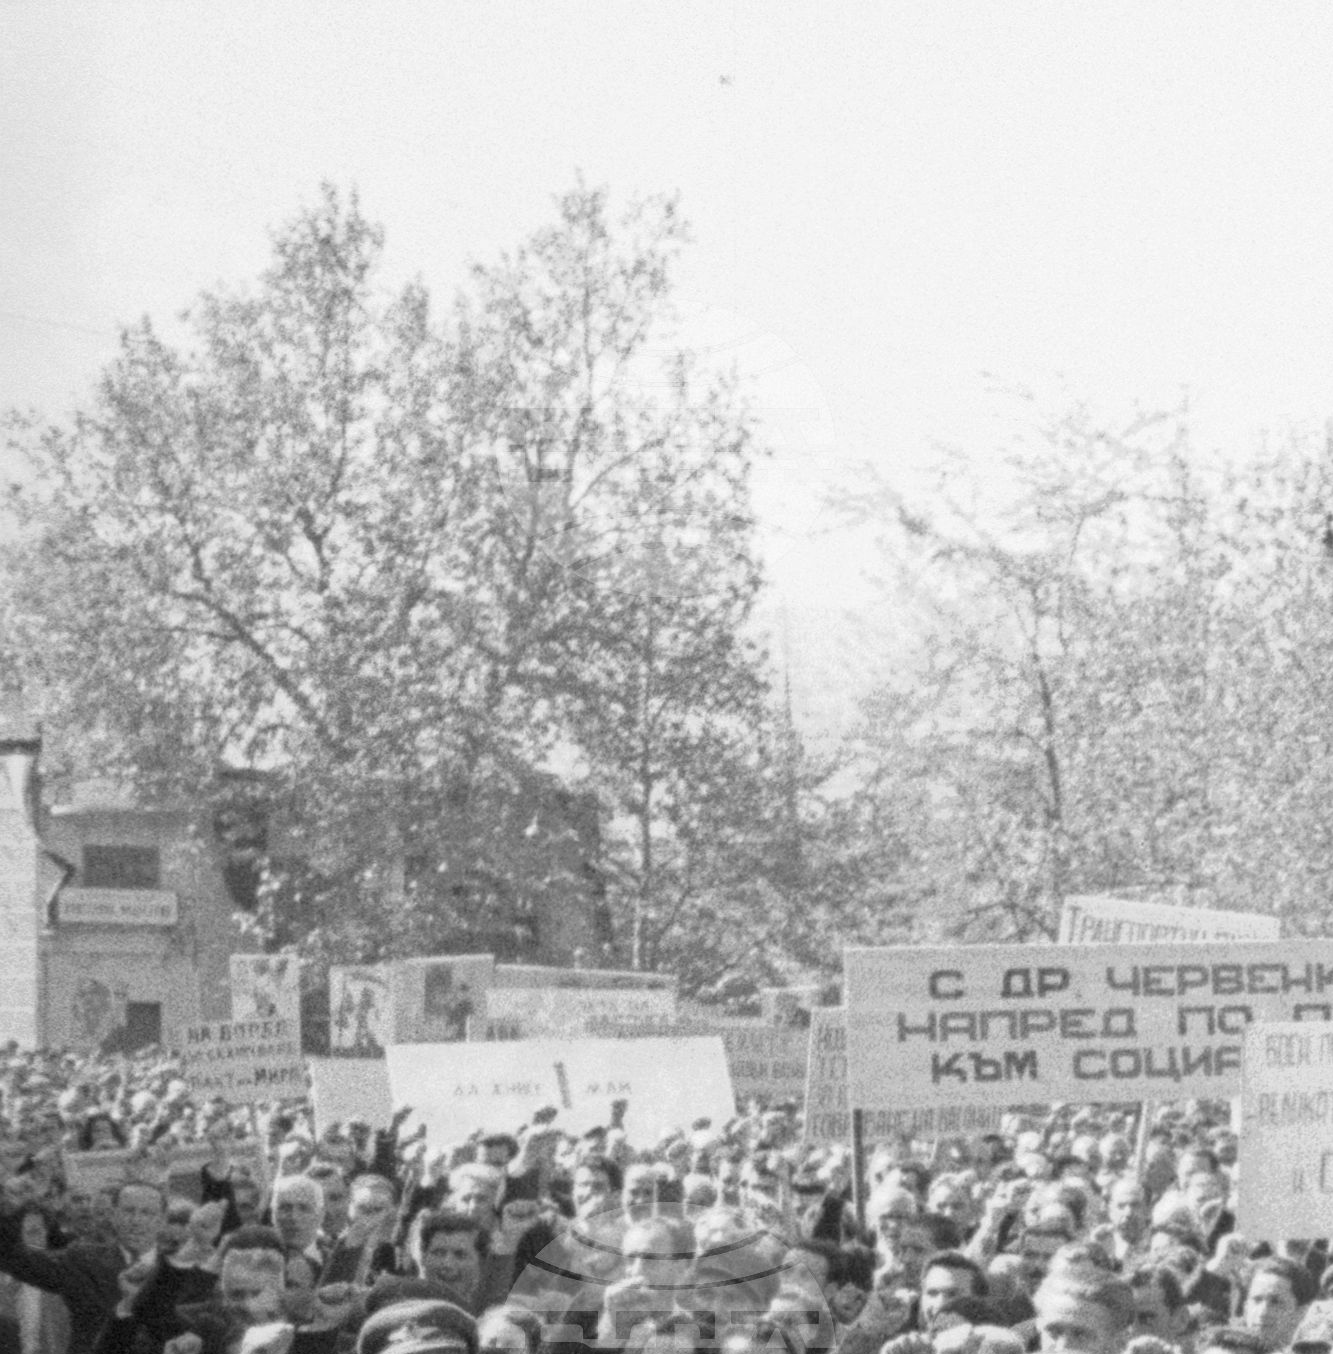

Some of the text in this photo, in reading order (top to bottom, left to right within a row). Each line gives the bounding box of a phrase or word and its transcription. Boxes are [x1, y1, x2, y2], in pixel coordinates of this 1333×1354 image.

[928, 968, 965, 999] С
[898, 1006, 1137, 1042] НАПРЕД
[1177, 1004, 1253, 1037] ПО
[931, 1049, 1038, 1084] КЪМ
